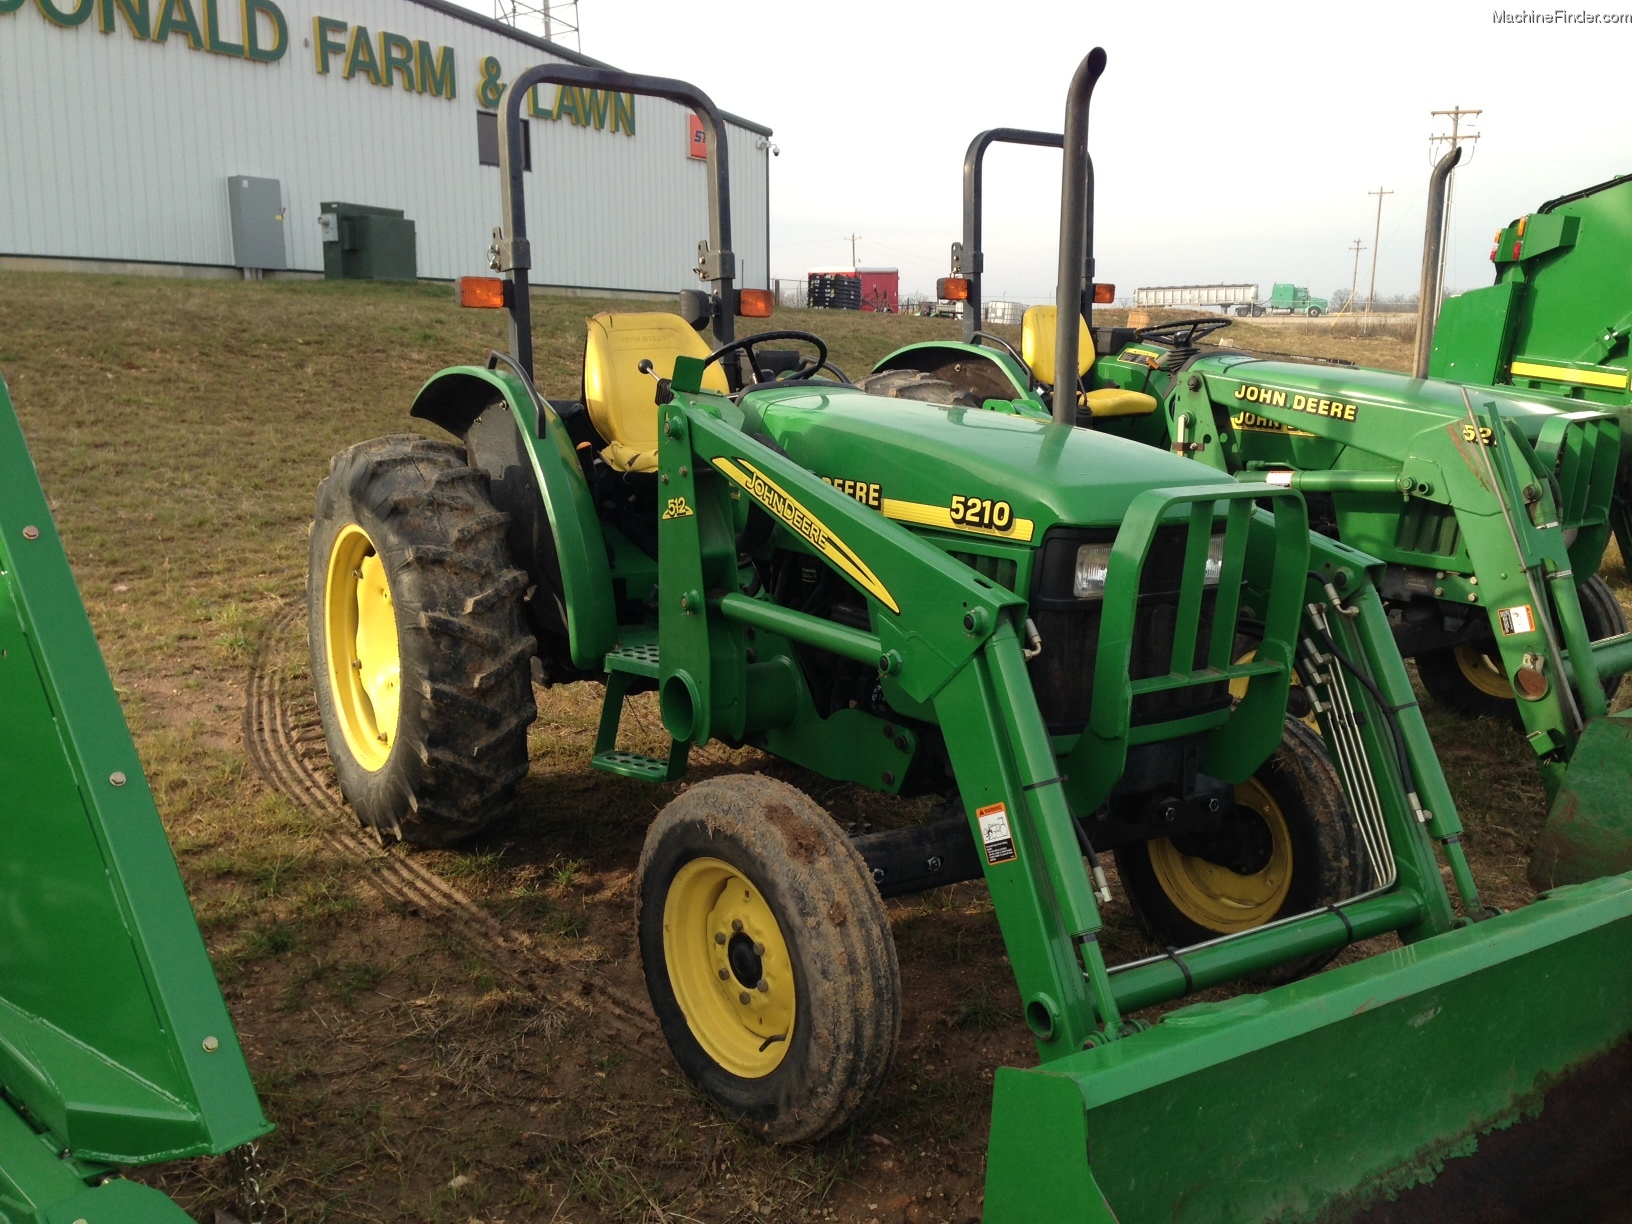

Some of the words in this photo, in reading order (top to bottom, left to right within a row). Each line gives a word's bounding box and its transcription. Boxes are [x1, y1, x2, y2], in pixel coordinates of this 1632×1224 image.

[313, 16, 457, 99] FARM
[477, 55, 507, 108] &
[527, 68, 636, 137] LAWN
[1234, 384, 1288, 408] JOHN
[1292, 394, 1358, 421] DEERE
[1462, 424, 1497, 447] 52
[667, 496, 687, 517] 512
[745, 471, 783, 512] JOHN
[782, 497, 829, 550] DEERE
[950, 495, 1011, 528] 5210
[984, 804, 1003, 814] WARNING
